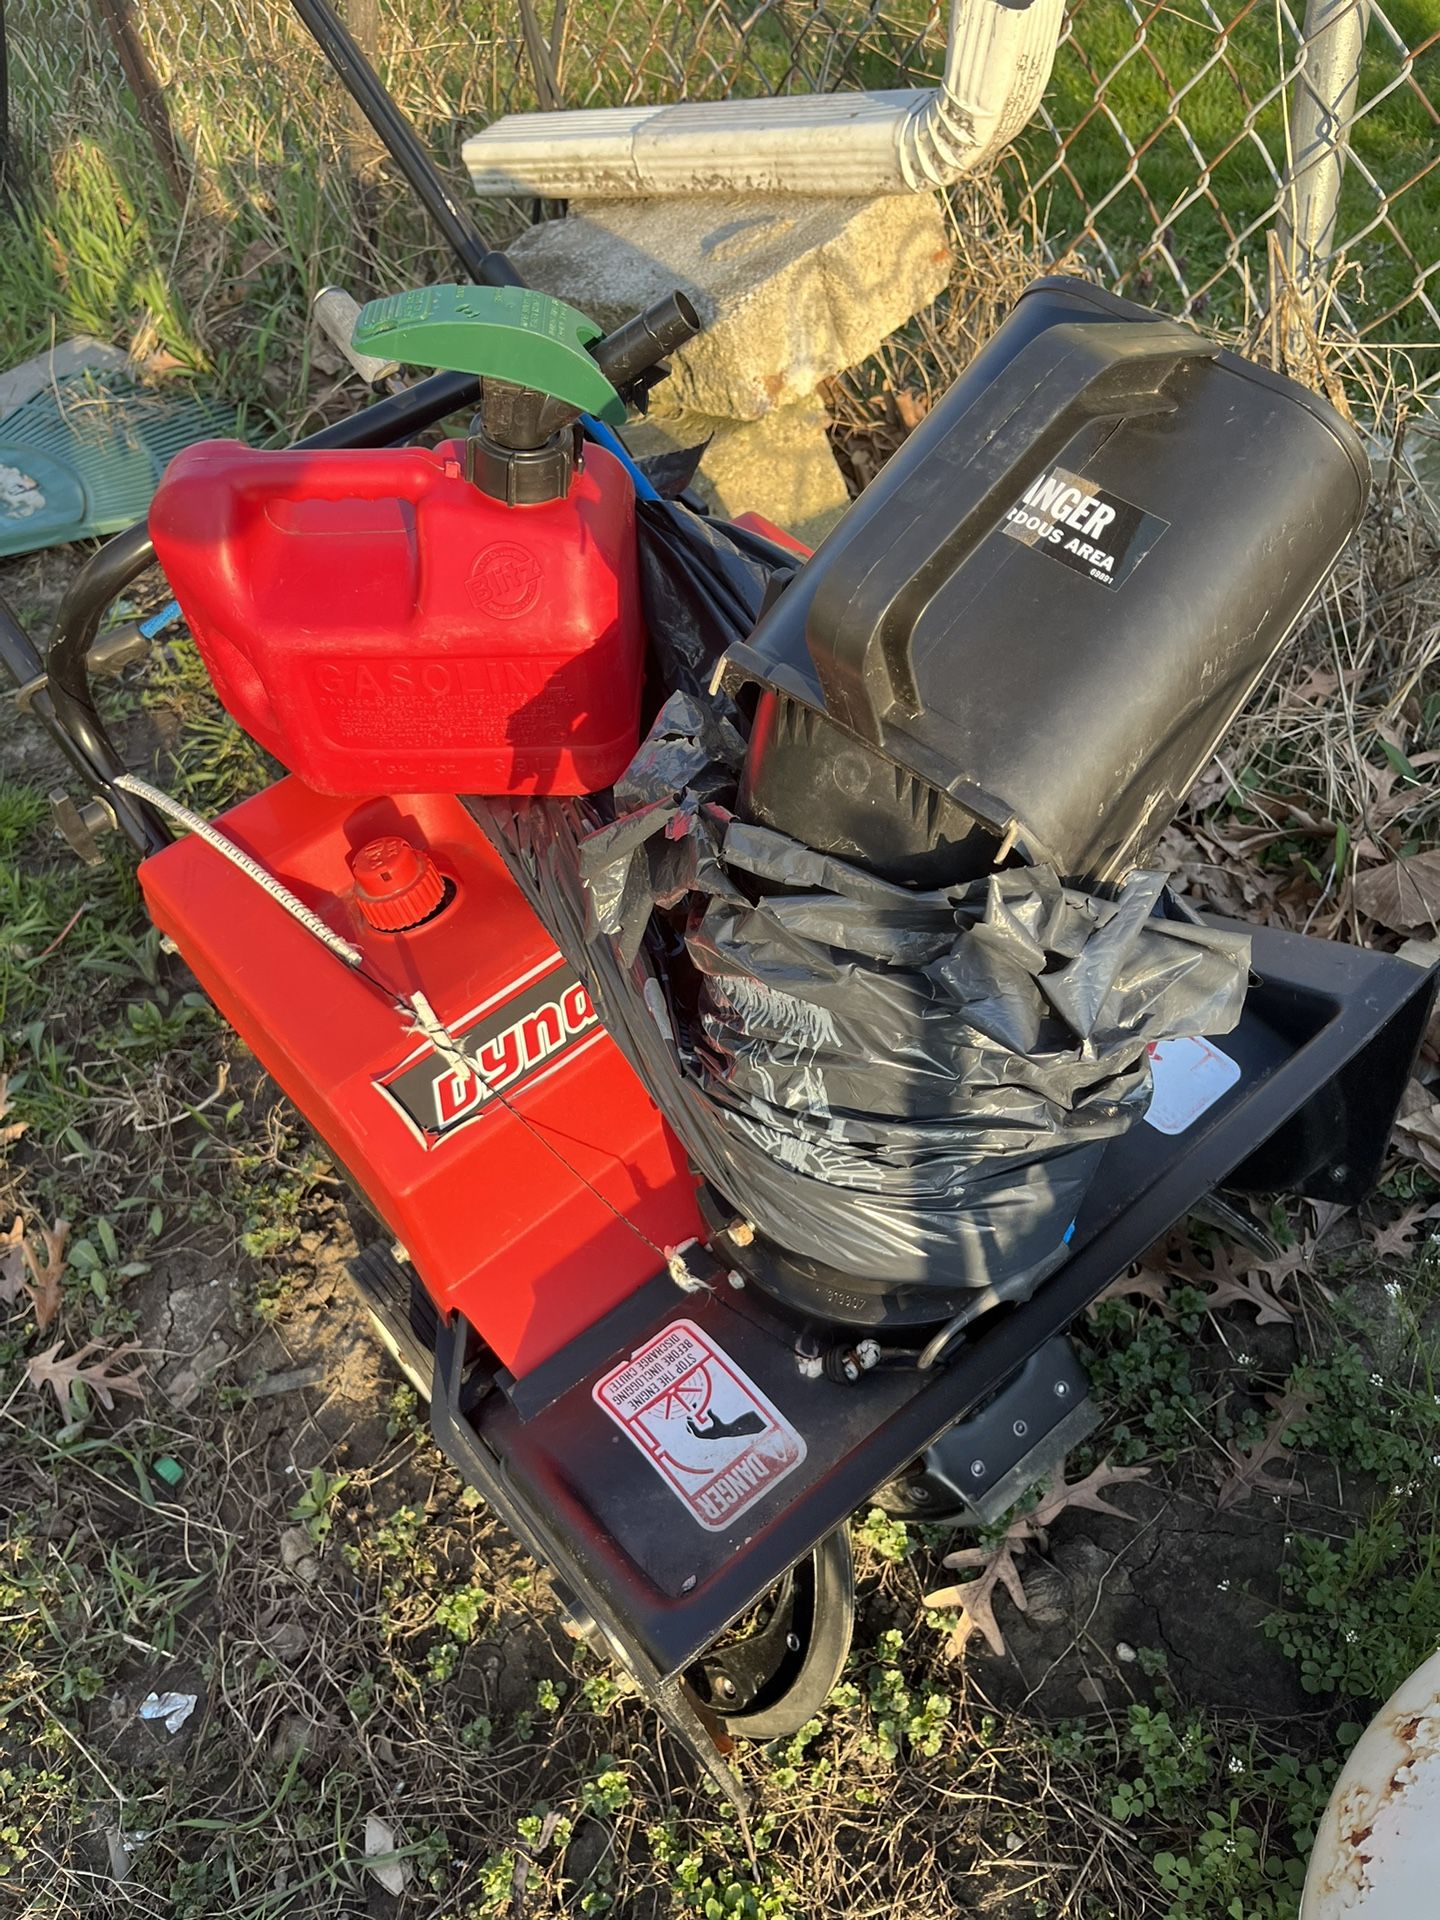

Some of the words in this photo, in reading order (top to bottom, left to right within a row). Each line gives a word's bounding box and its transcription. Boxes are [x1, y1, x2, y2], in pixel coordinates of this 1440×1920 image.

[1064, 538, 1115, 571] AREA
[313, 662, 566, 696] GASOLINE
[638, 1333, 681, 1373] DISCHARGE
[662, 1339, 695, 1368] BEFORE
[675, 1353, 697, 1375] STOP
[608, 1366, 640, 1394] CHUTE!
[611, 1362, 666, 1406] UNCLOGGING
[657, 1370, 677, 1389] THE
[629, 1382, 661, 1411] ENGINE
[695, 1453, 770, 1519] DANGER
